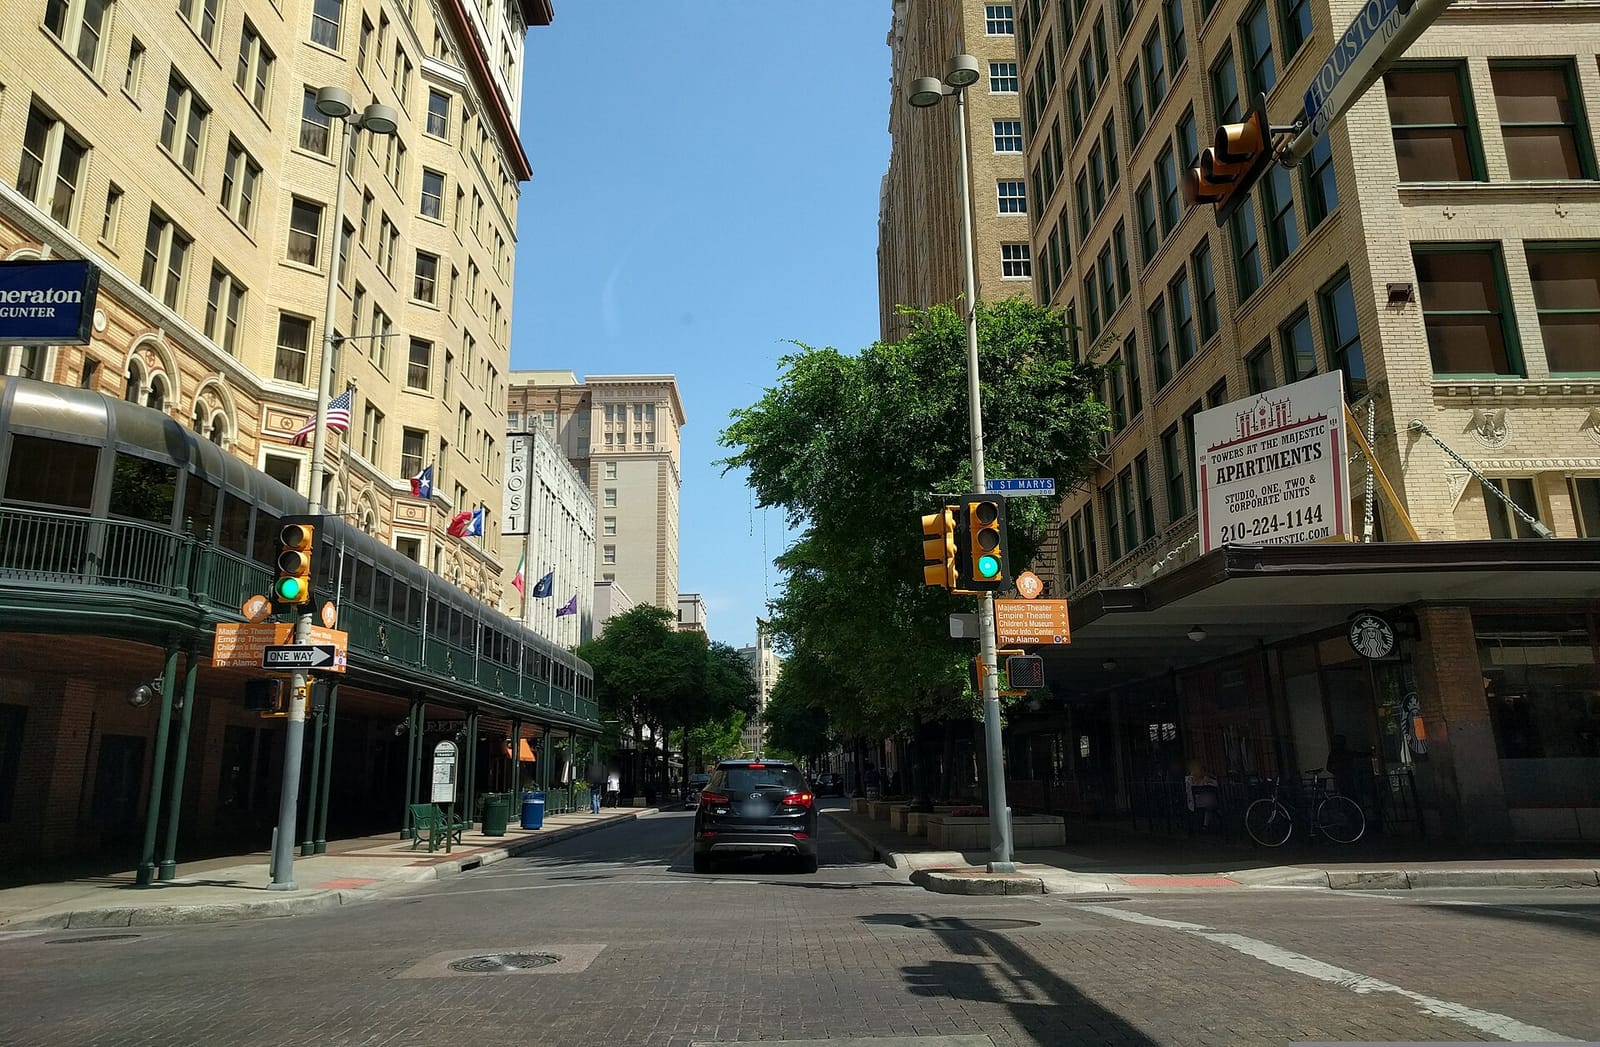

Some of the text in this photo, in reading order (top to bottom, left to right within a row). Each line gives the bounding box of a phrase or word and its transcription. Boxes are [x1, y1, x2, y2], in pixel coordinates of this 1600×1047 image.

[1318, 9, 1400, 131] 200 100
[0, 307, 55, 318] GUNTER
[1211, 425, 1324, 464] TOWERS AT THE MAJESTIC
[1216, 442, 1322, 484] APARTMENTS
[508, 439, 525, 530] FROST
[1000, 481, 1012, 489] ST
[1018, 480, 1052, 488] MARYS
[1225, 474, 1317, 504] STUDIO, ONE, TWO &
[1230, 487, 1310, 513] CORPORATE UNITS
[1221, 504, 1322, 543] 210-224-1144
[270, 652, 288, 660] ONE
[293, 652, 314, 660] WAY
